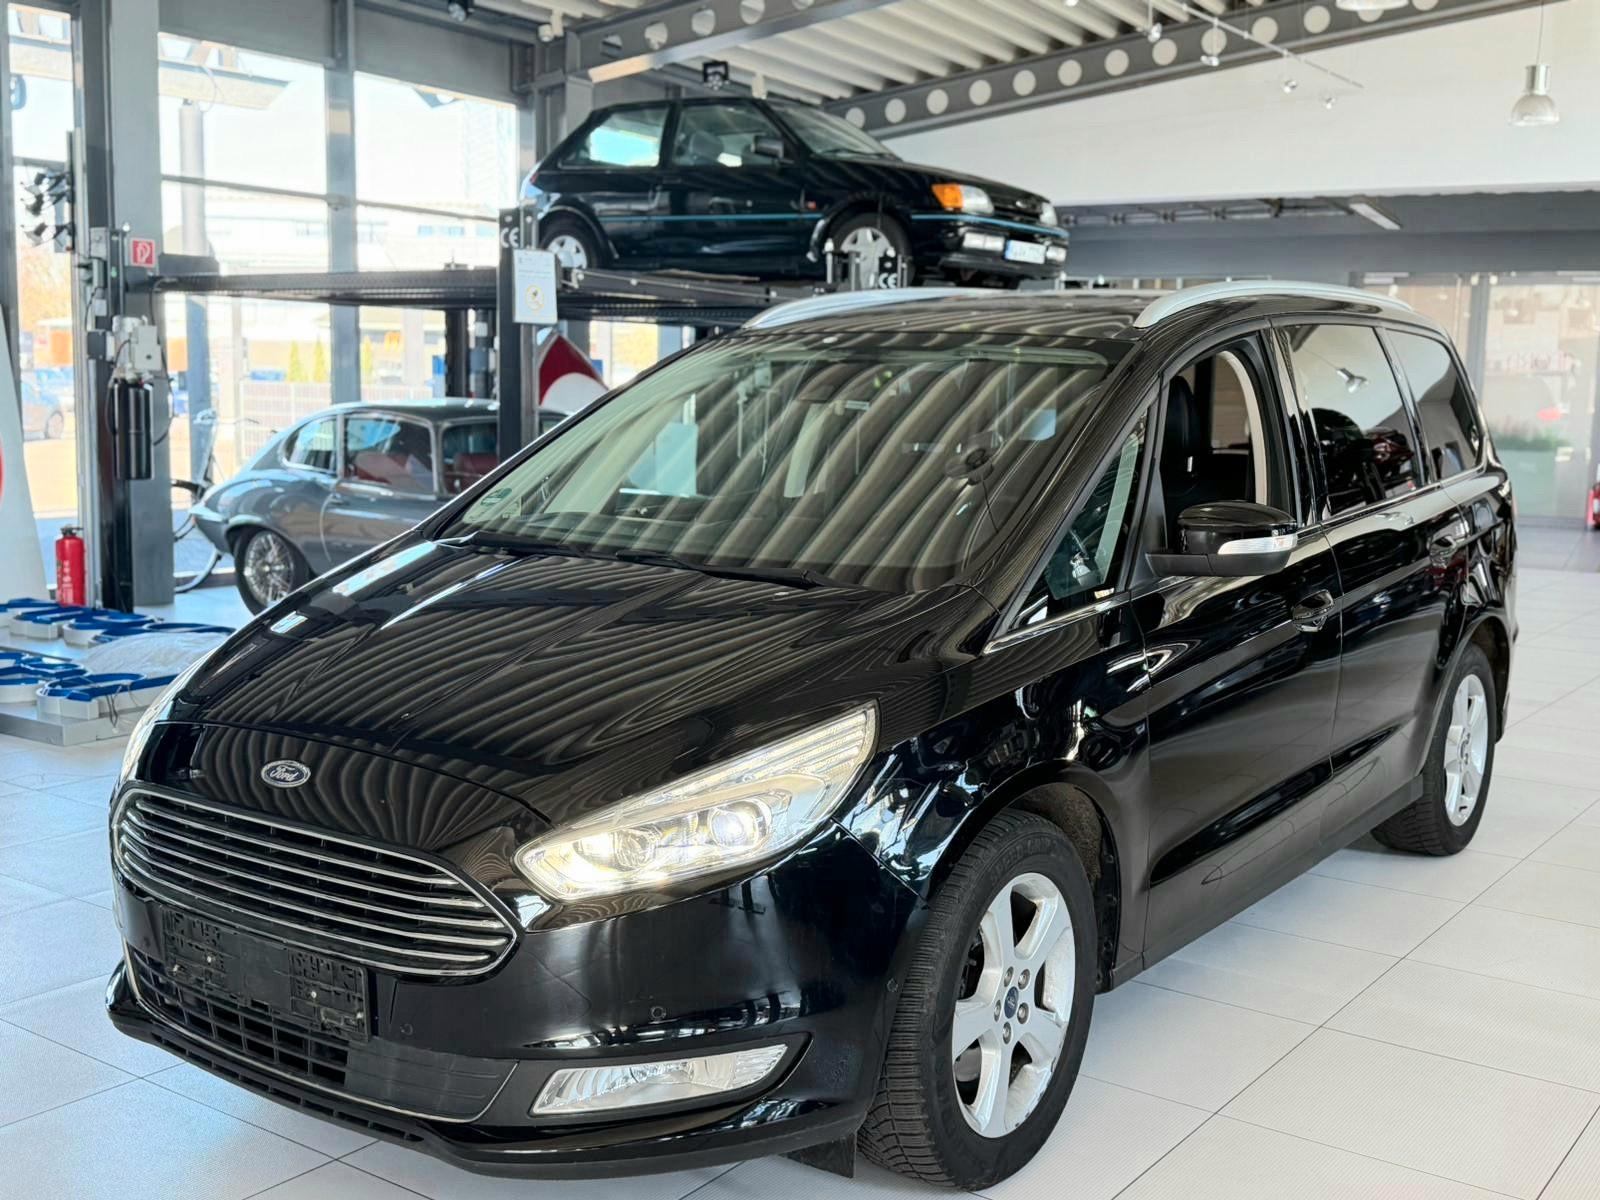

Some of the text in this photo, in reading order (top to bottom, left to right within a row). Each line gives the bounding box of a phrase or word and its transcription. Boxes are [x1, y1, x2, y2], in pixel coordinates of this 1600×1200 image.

[501, 227, 519, 248] CE
[878, 272, 897, 289] CE
[269, 764, 299, 782] Ford
